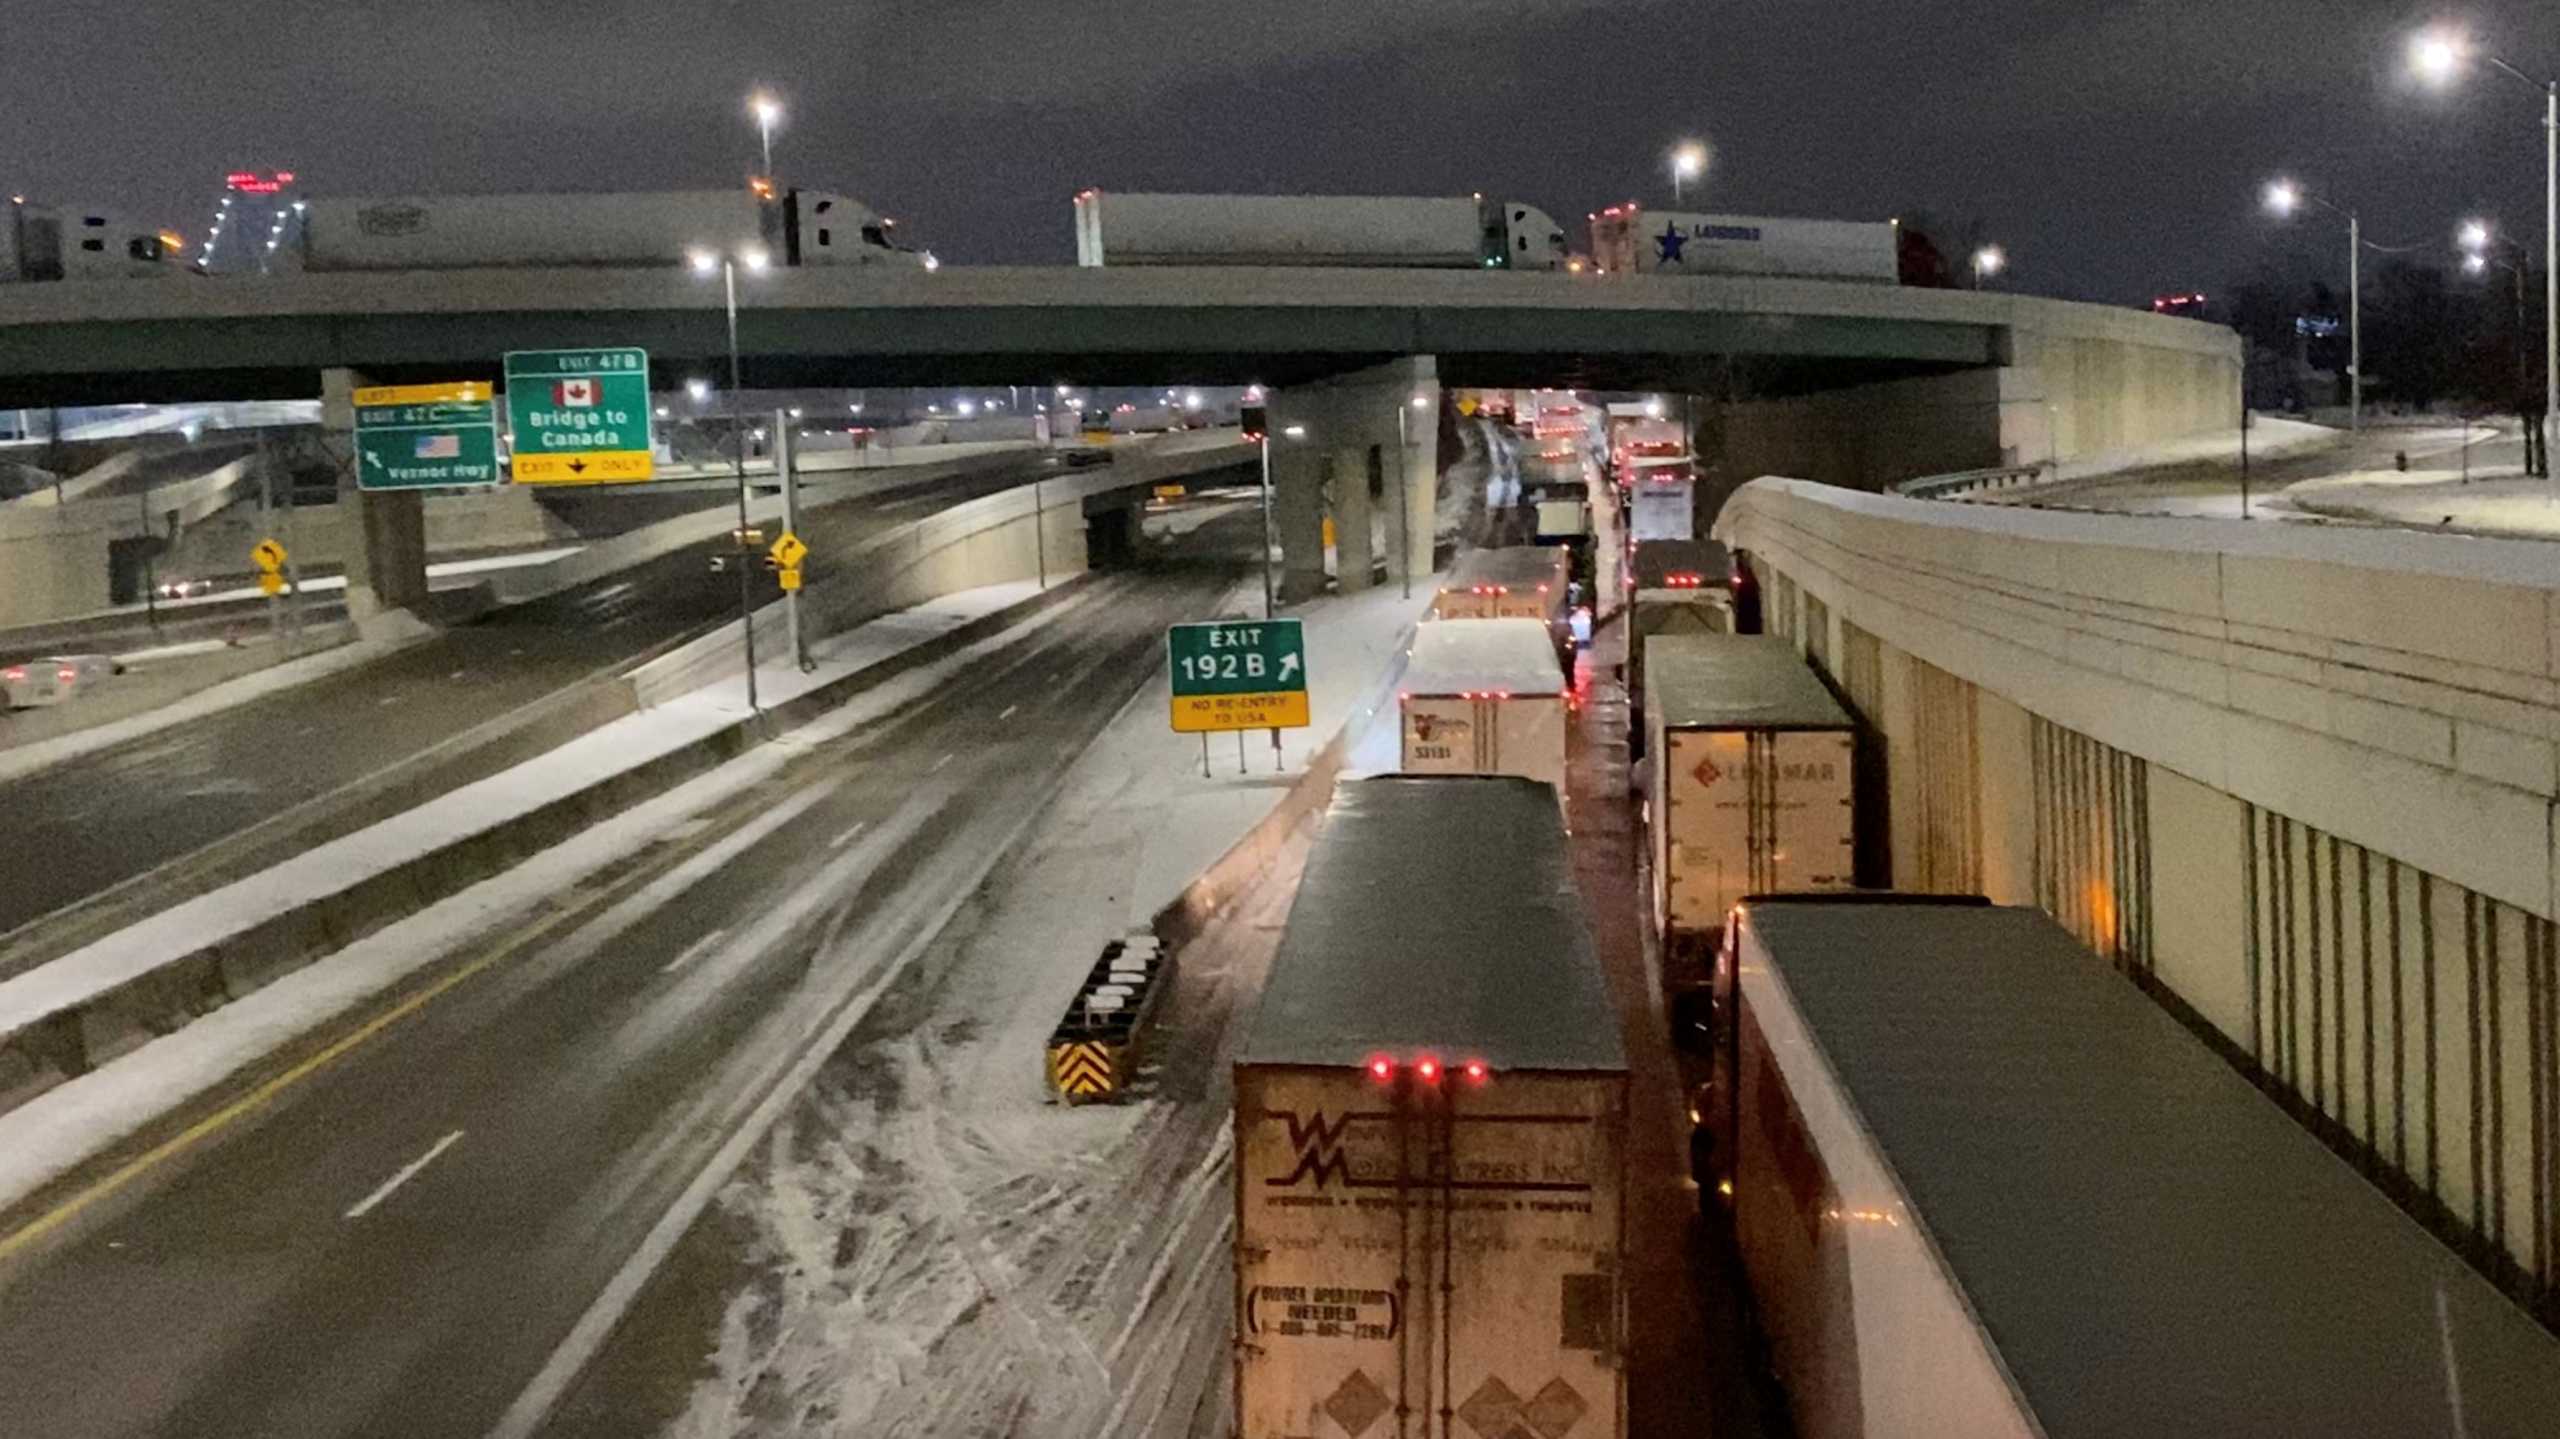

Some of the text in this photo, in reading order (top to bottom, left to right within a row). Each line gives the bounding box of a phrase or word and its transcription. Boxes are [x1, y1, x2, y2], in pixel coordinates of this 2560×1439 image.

[559, 356, 592, 370] EXIT
[530, 409, 628, 430] Bridge to
[541, 429, 619, 447] Canada
[453, 464, 489, 481] Hwy
[521, 459, 640, 474] EXIT ONLY
[1209, 628, 1262, 648] EXIT
[1191, 699, 1211, 711] NO
[1215, 713, 1231, 723] TO
[1287, 1304, 1357, 1321] NEEDED
